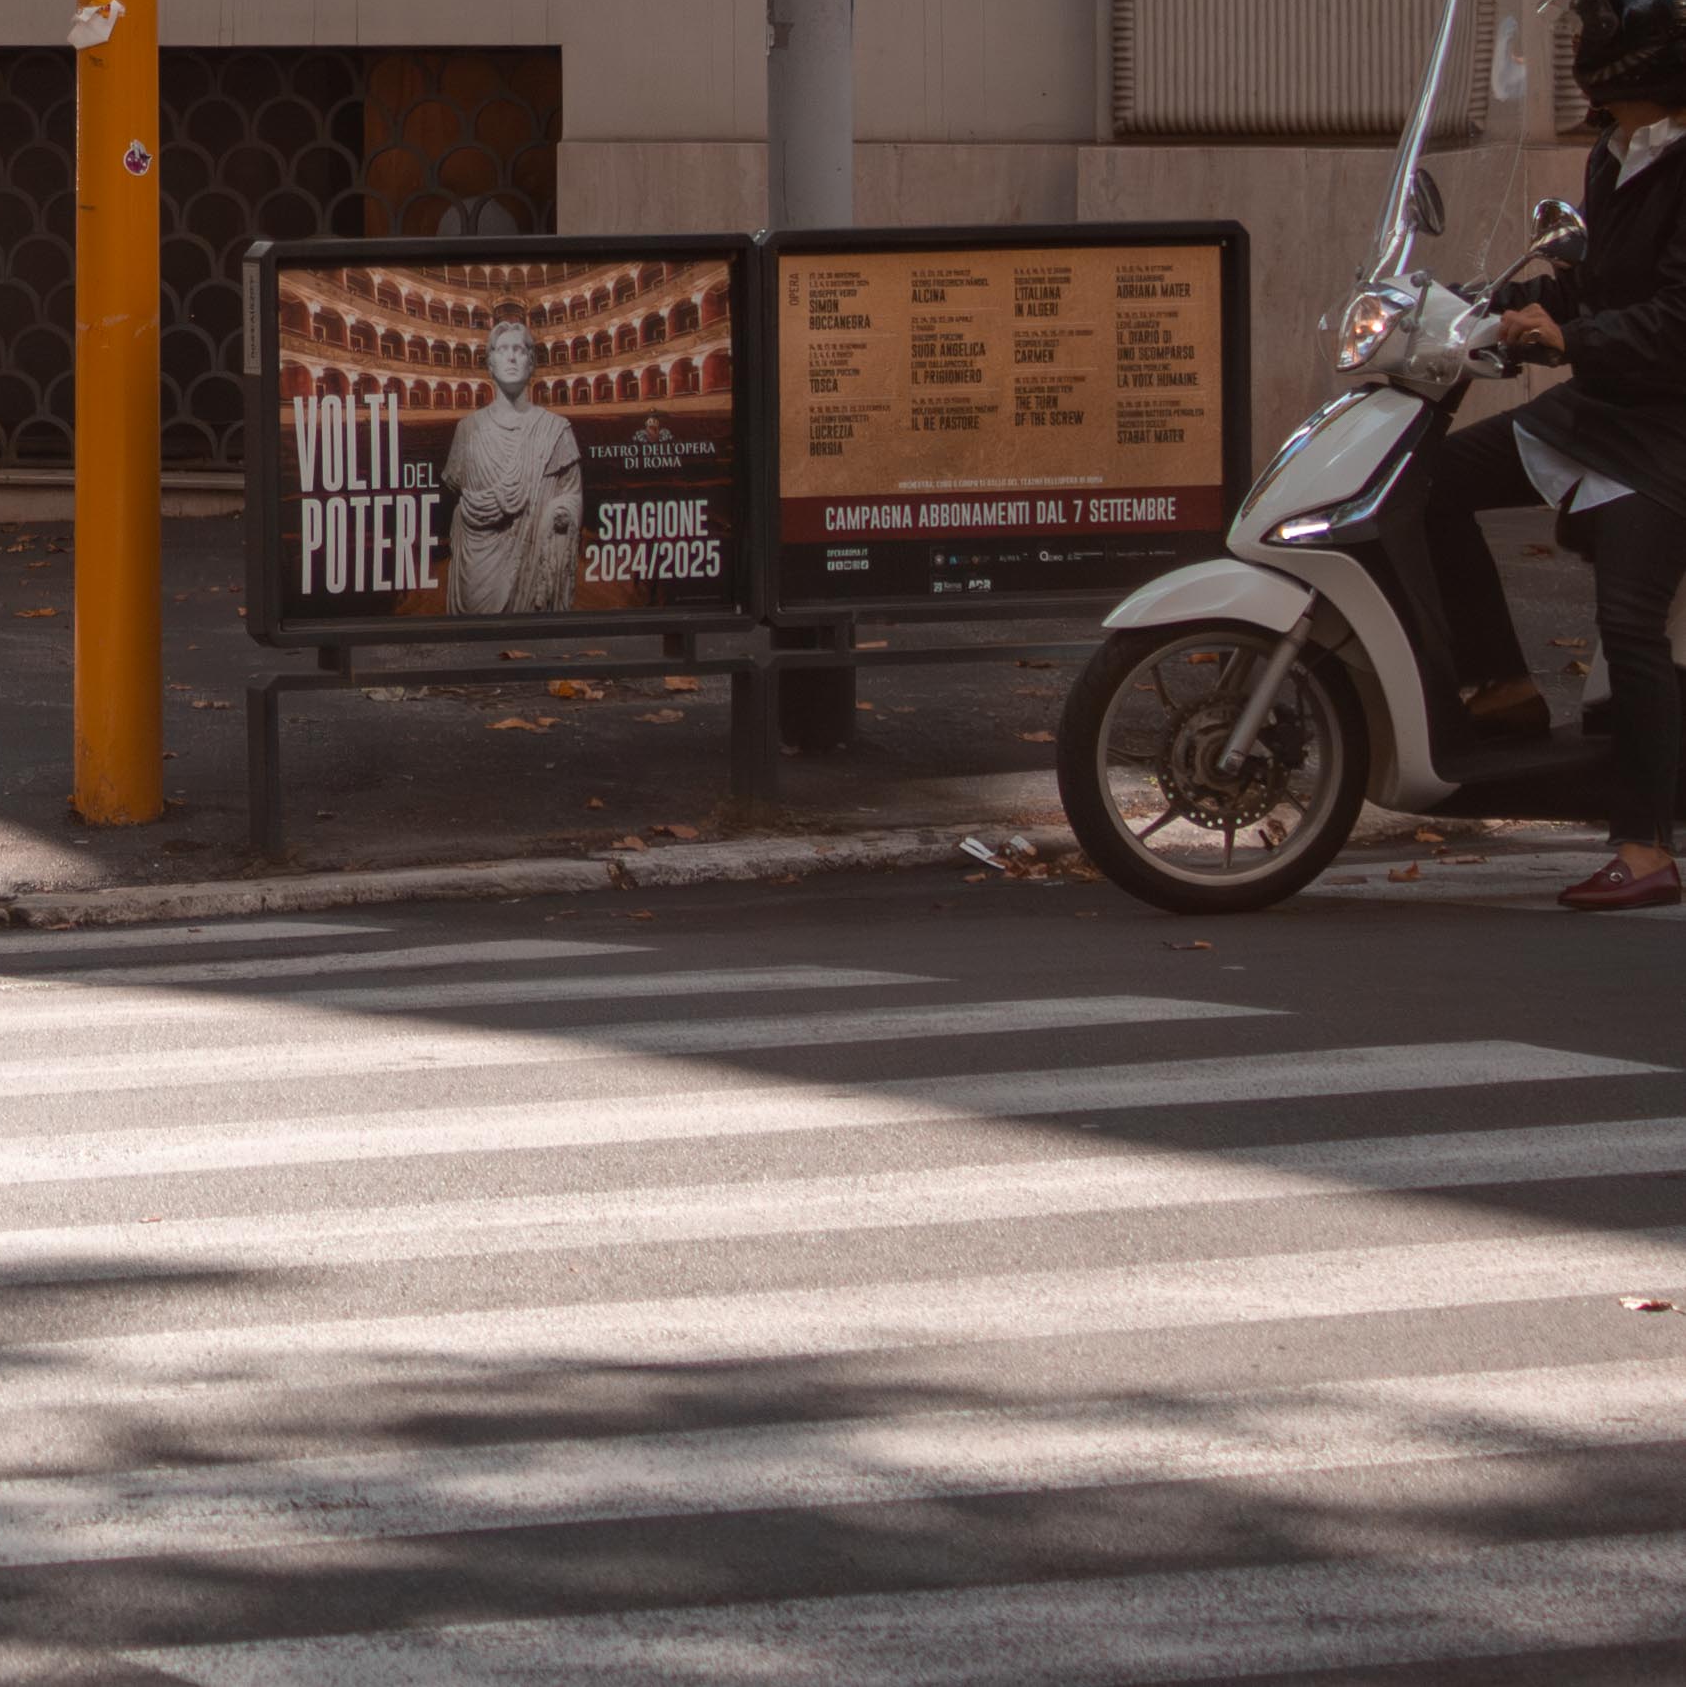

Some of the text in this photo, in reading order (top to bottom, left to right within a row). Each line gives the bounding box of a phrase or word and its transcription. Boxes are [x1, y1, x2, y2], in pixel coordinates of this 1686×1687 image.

[789, 273, 800, 306] OPERA
[912, 289, 947, 303] ALCINA
[1116, 283, 1191, 298] ADRIANA MATER
[809, 299, 839, 314] SIMON
[1015, 303, 1059, 317] IN ALGERI
[809, 315, 871, 330] BOCCANEGRA
[1117, 330, 1172, 344] IL DIARIO DI
[911, 343, 986, 358] SUOR ANGELICA
[1015, 350, 1055, 363] CARMEN
[1117, 346, 1195, 360] UNO SCOMPARSO
[912, 369, 982, 384] IL PRIGIONIERO
[1117, 372, 1198, 388] LA VOIX HUMAINE
[810, 379, 839, 393] TOSCA
[1015, 396, 1058, 410] THE TURN
[912, 416, 980, 430] IL RE PASTORE
[1015, 411, 1085, 426] OF THE SCREW
[810, 425, 854, 439] LUCREZIA
[1117, 429, 1185, 444] STABAT MATER
[294, 393, 439, 492] VOLTI DEL
[589, 442, 715, 458] TEATRO DELL'OPERA
[810, 441, 843, 456] BORGIA
[625, 456, 682, 469] DI ROMA
[598, 500, 708, 541] STAGIONE
[825, 497, 1177, 531] CAMPAGNA ABBONAMENTI DAL 7 SETTEMBRE
[302, 494, 440, 595] POTERE
[585, 540, 720, 582] 2024/2025
